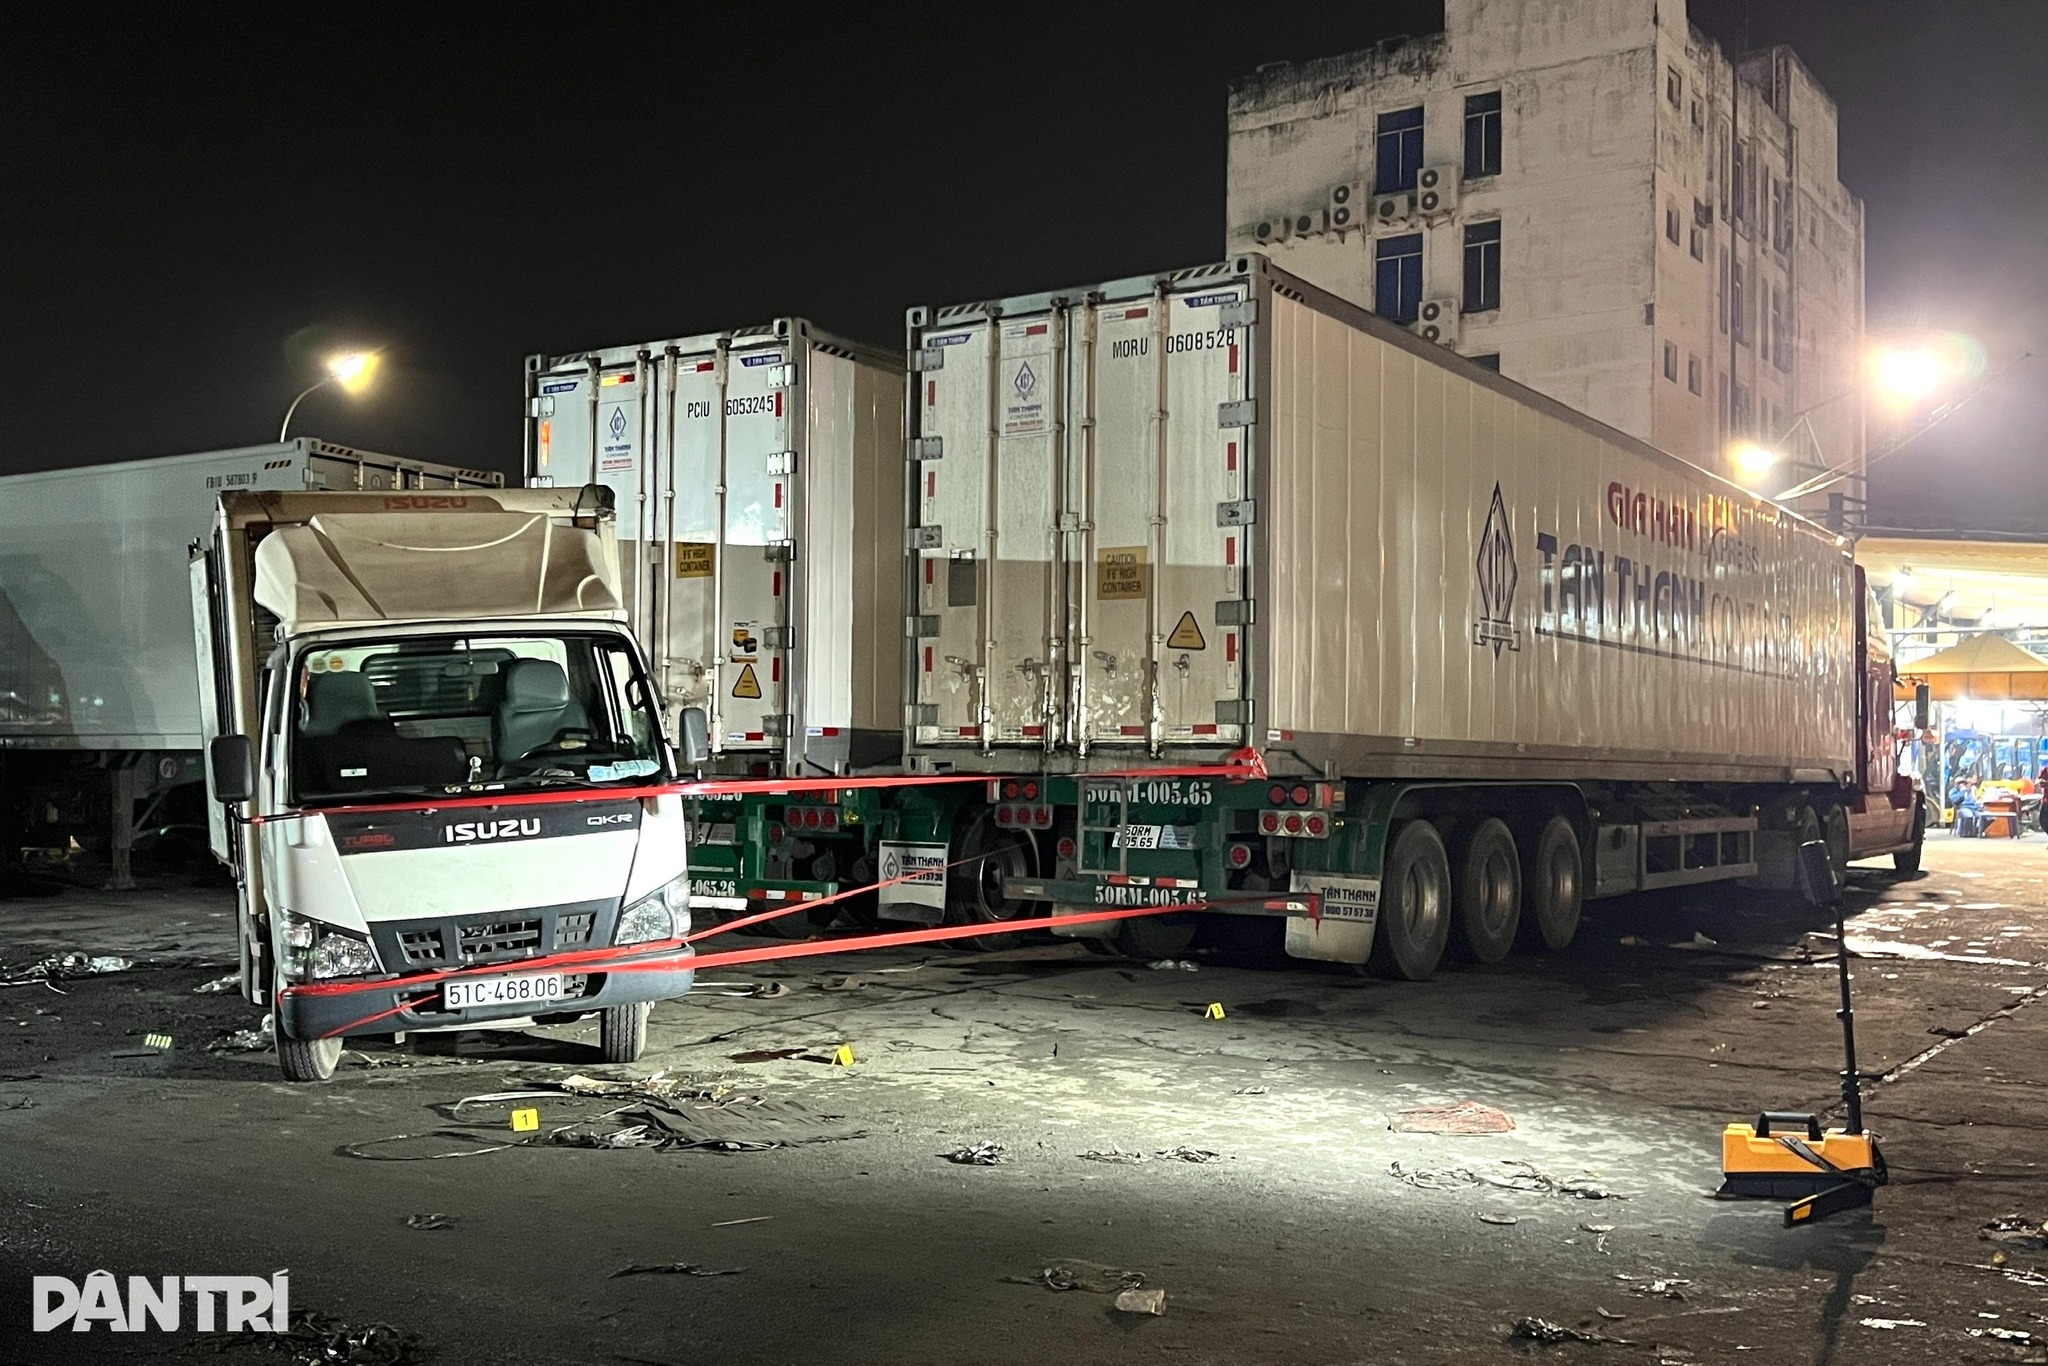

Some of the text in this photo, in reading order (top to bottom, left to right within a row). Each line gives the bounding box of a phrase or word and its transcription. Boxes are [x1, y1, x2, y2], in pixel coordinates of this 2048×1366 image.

[1112, 328, 1235, 359] MORU 0608528
[687, 395, 774, 418] PCIU 6053245
[383, 496, 468, 510] ISUZU
[680, 560, 711, 572] CONTAINER
[1106, 553, 1137, 566] CAUTION
[1102, 581, 1142, 593] CONTAINER
[446, 817, 541, 843] ISUZU
[587, 813, 633, 826] QKR
[917, 857, 944, 867] THANH
[1342, 889, 1377, 902] THANH
[449, 977, 559, 1006] 51C-468.06
[521, 1113, 528, 1126] 1
